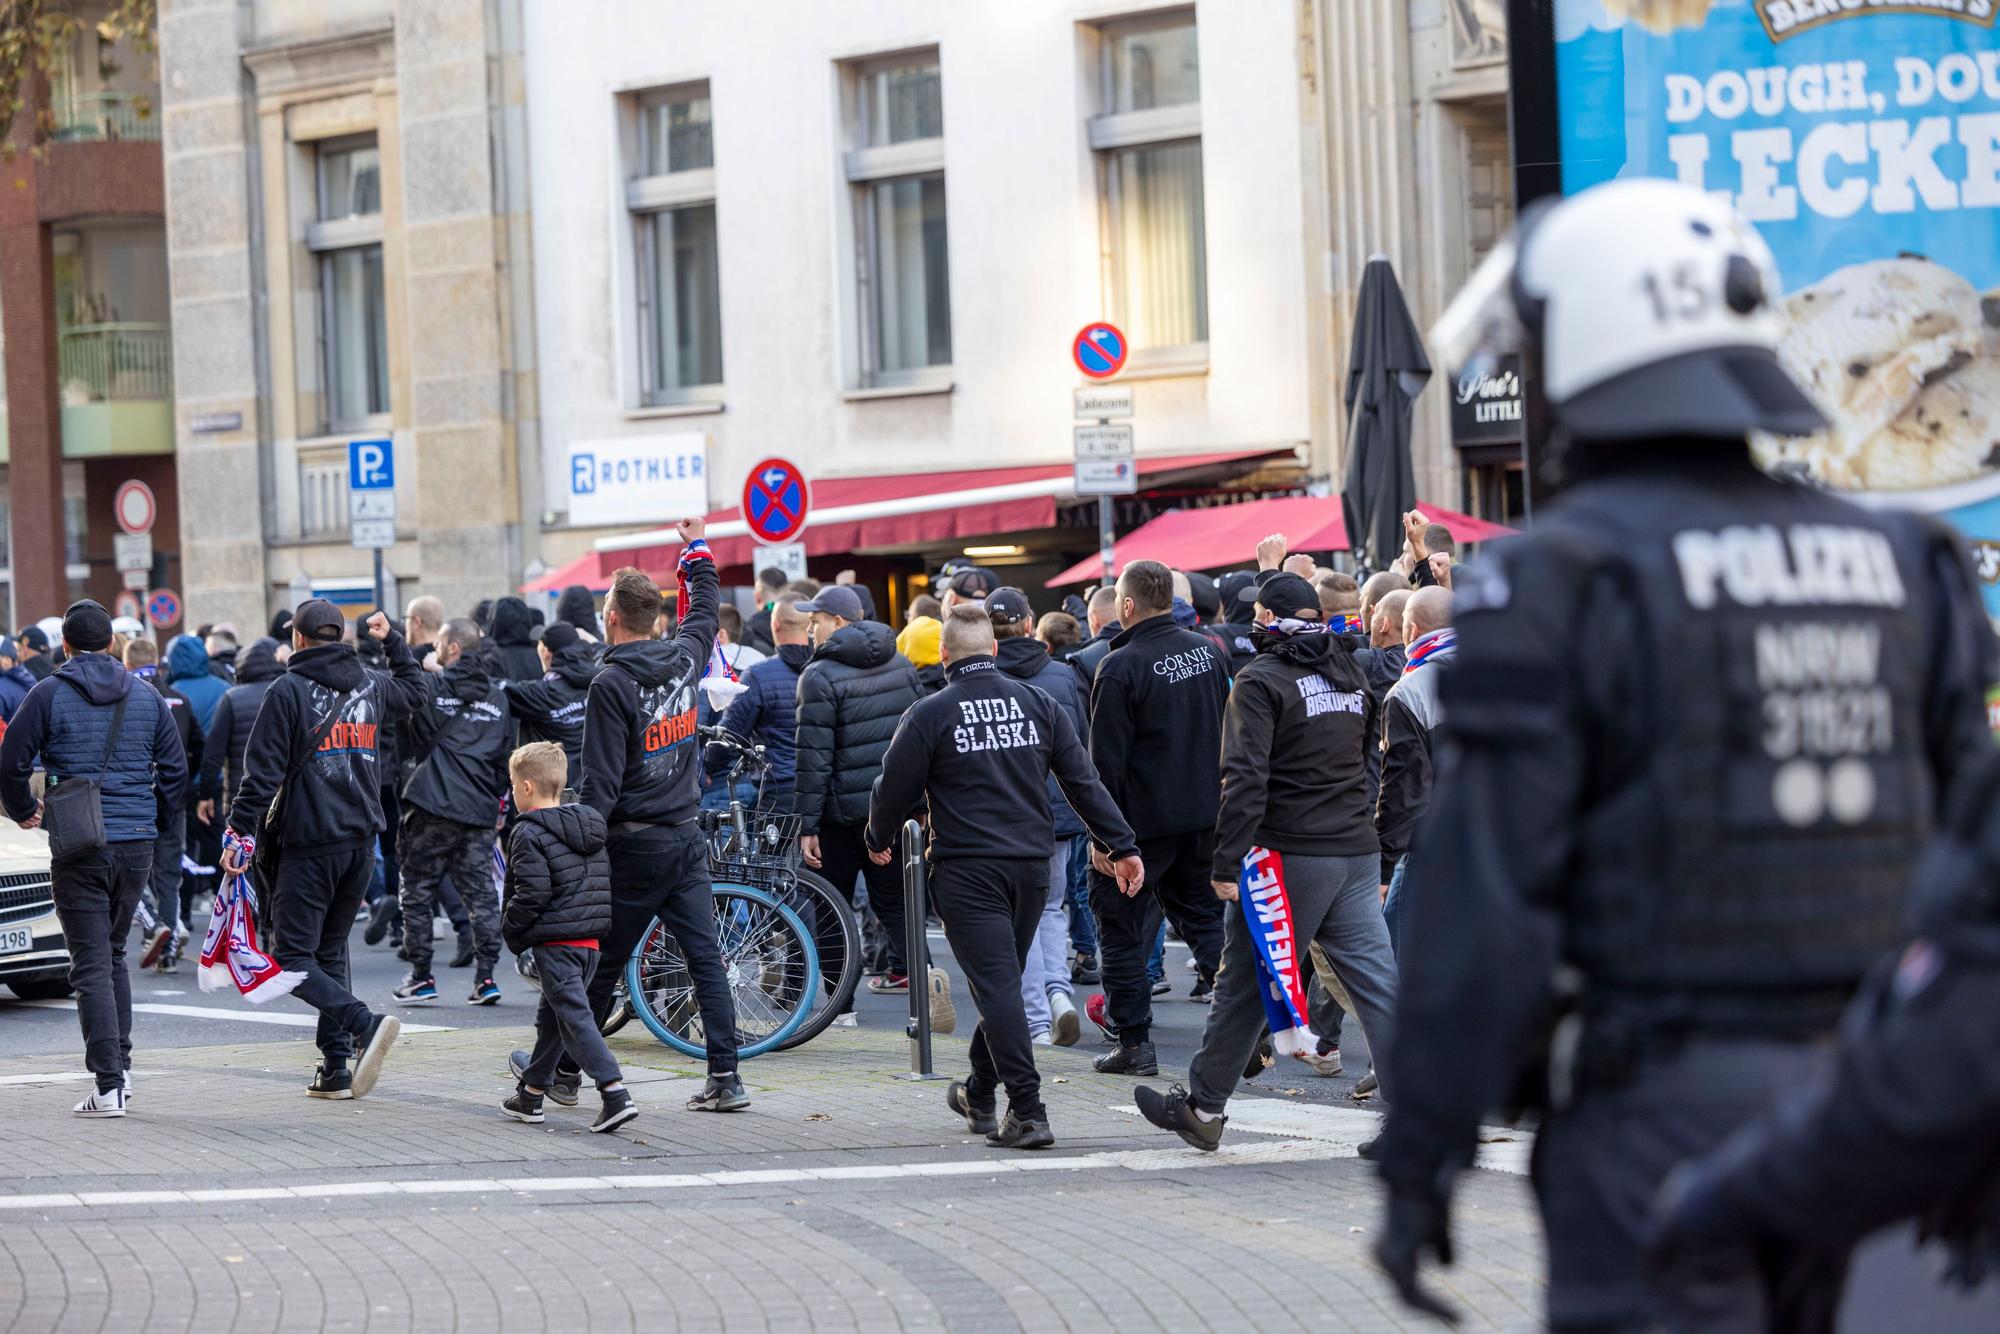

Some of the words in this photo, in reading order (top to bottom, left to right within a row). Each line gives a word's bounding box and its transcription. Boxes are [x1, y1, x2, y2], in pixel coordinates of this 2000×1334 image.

[1664, 60, 1886, 122] DOUGH,
[1475, 400, 1521, 422] LITTLE
[358, 445, 384, 485] P
[602, 455, 702, 483] ROTHLER
[1672, 523, 1905, 609] POLIZEI
[1153, 646, 1214, 675] GÓRNIK
[1166, 661, 1209, 684] ZABRZE
[959, 696, 1025, 725] RUDA
[1305, 692, 1364, 717] BISKUPICE
[645, 704, 699, 752] GÓRNI
[953, 720, 1041, 754] ŚLĄSKA
[0, 931, 27, 950] 198
